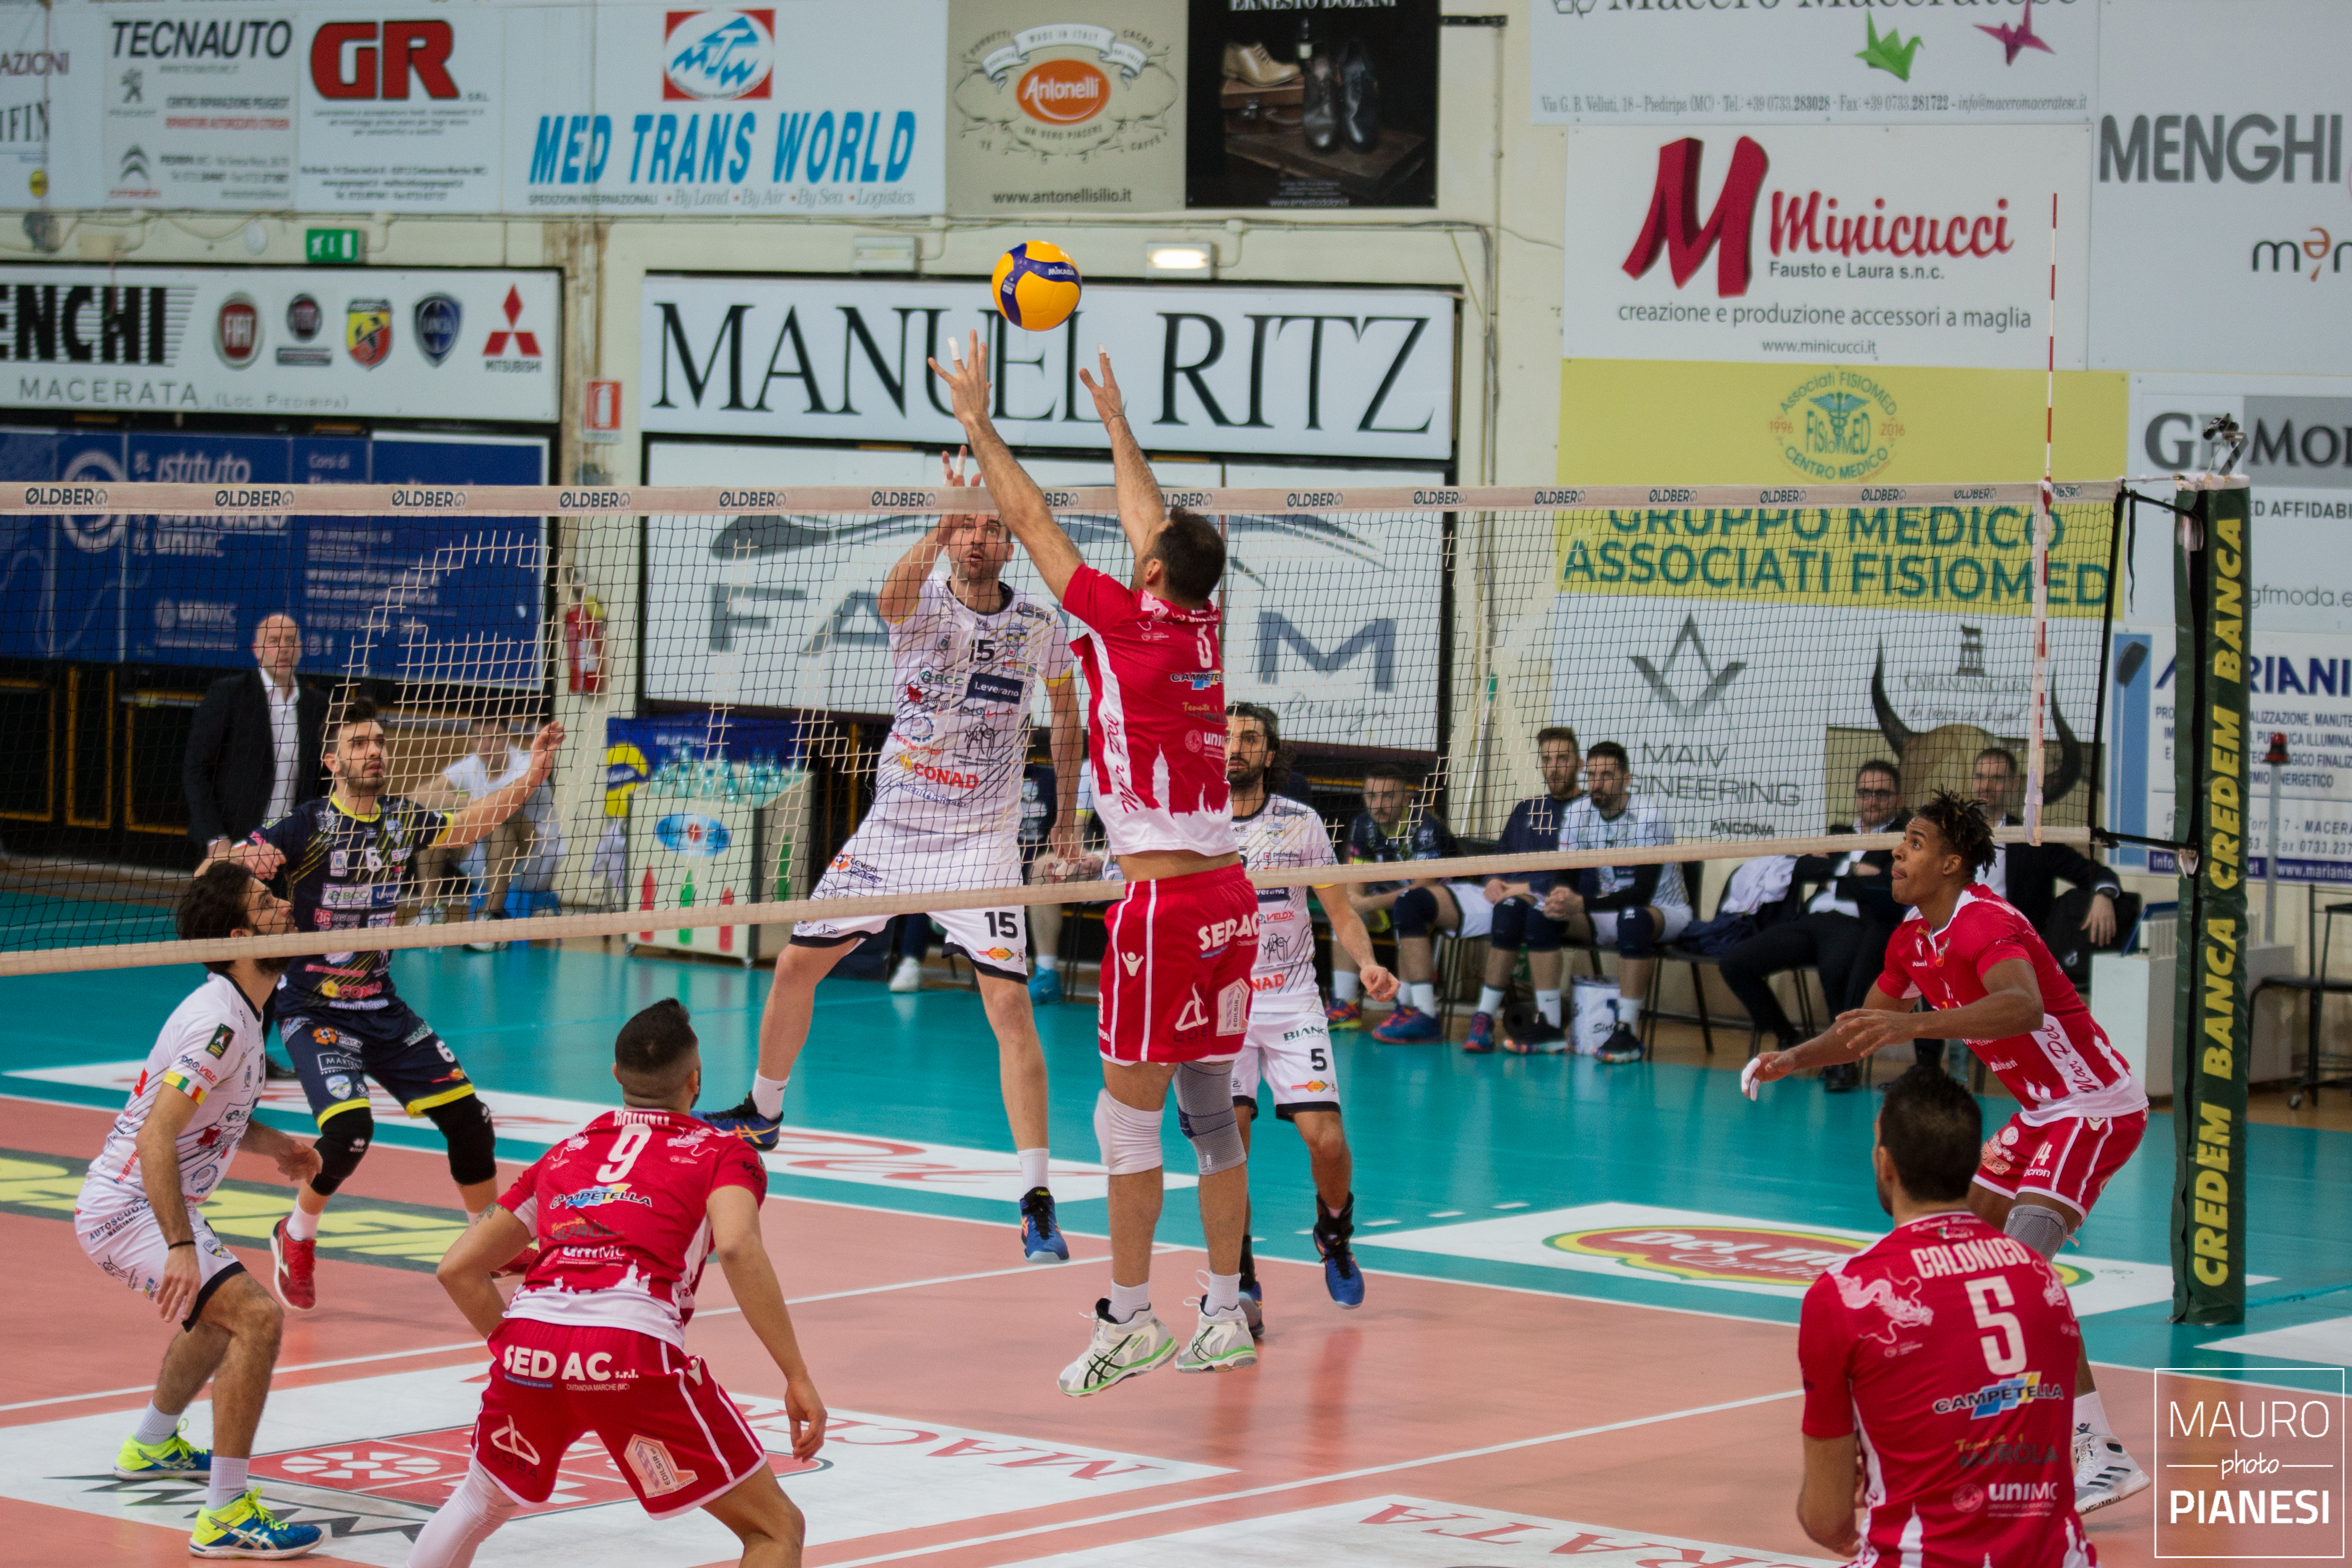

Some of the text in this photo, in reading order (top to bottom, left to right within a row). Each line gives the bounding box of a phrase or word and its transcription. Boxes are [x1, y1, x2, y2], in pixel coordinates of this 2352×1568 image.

[111, 20, 292, 58] TECNAUTO
[310, 19, 460, 101] GR
[1023, 75, 1101, 101] Antonelli
[1542, 95, 1558, 113] Via
[1560, 96, 1572, 112] G.
[1574, 96, 1583, 112] B.
[1623, 96, 1634, 112] 18
[1645, 95, 1686, 116] Piediripa
[1690, 95, 1715, 115] (MC)
[1746, 96, 1765, 113] +39
[1767, 95, 1830, 112] 0733.283028
[1864, 95, 1883, 113] +39
[1885, 94, 1949, 112] 0733.281722
[529, 115, 613, 185] MED
[630, 112, 756, 184] TRANS
[772, 110, 917, 183] WORLD
[2100, 114, 2343, 184] MENGHI
[856, 188, 916, 208] Logistics
[993, 187, 1132, 205] www.antonellisilio.it
[1769, 190, 2014, 258] Minicucci
[1048, 266, 1075, 276] MIKASA
[1770, 262, 1945, 280] Fausto e Laura s.n.c.
[0, 285, 167, 366] NCHI
[1619, 303, 2032, 334] creazione e produzione accessori a maglia
[1762, 337, 1877, 356] www.minicucci.it
[485, 359, 542, 373] MITSUBISHI
[652, 302, 1435, 434] MANUEL RITZ
[18, 377, 199, 407] MACERATA
[1780, 371, 1835, 414] Associati
[1769, 420, 1794, 435] 1996
[1880, 421, 1906, 437] 2016
[1785, 444, 1889, 481] CENTRO MEDICO
[1562, 540, 1832, 594] ASSOCIATI
[969, 639, 996, 663] 15
[974, 680, 1020, 699] Leverano
[2209, 518, 2243, 890] CREDEM BANCA
[1643, 743, 1728, 768] MAIV
[914, 763, 980, 790] CONAD
[1712, 821, 1775, 837] ANCONA
[366, 847, 382, 872] 6
[984, 911, 1018, 939] 15
[436, 1039, 456, 1063] 6
[1311, 1048, 1328, 1072] 5
[2194, 918, 2236, 1287] CREDEM BANCA
[596, 1123, 653, 1183] 9
[550, 1191, 653, 1210] CAMPETELLA
[107, 1215, 136, 1238] MAGLIANI
[1910, 1237, 2032, 1279] CALONICO
[1964, 1275, 2028, 1376] 5
[566, 1383, 593, 1391] CIVITANOVA
[1934, 1382, 2064, 1413] CAMPETELLA
[655, 1455, 671, 1486] EDILSIR
